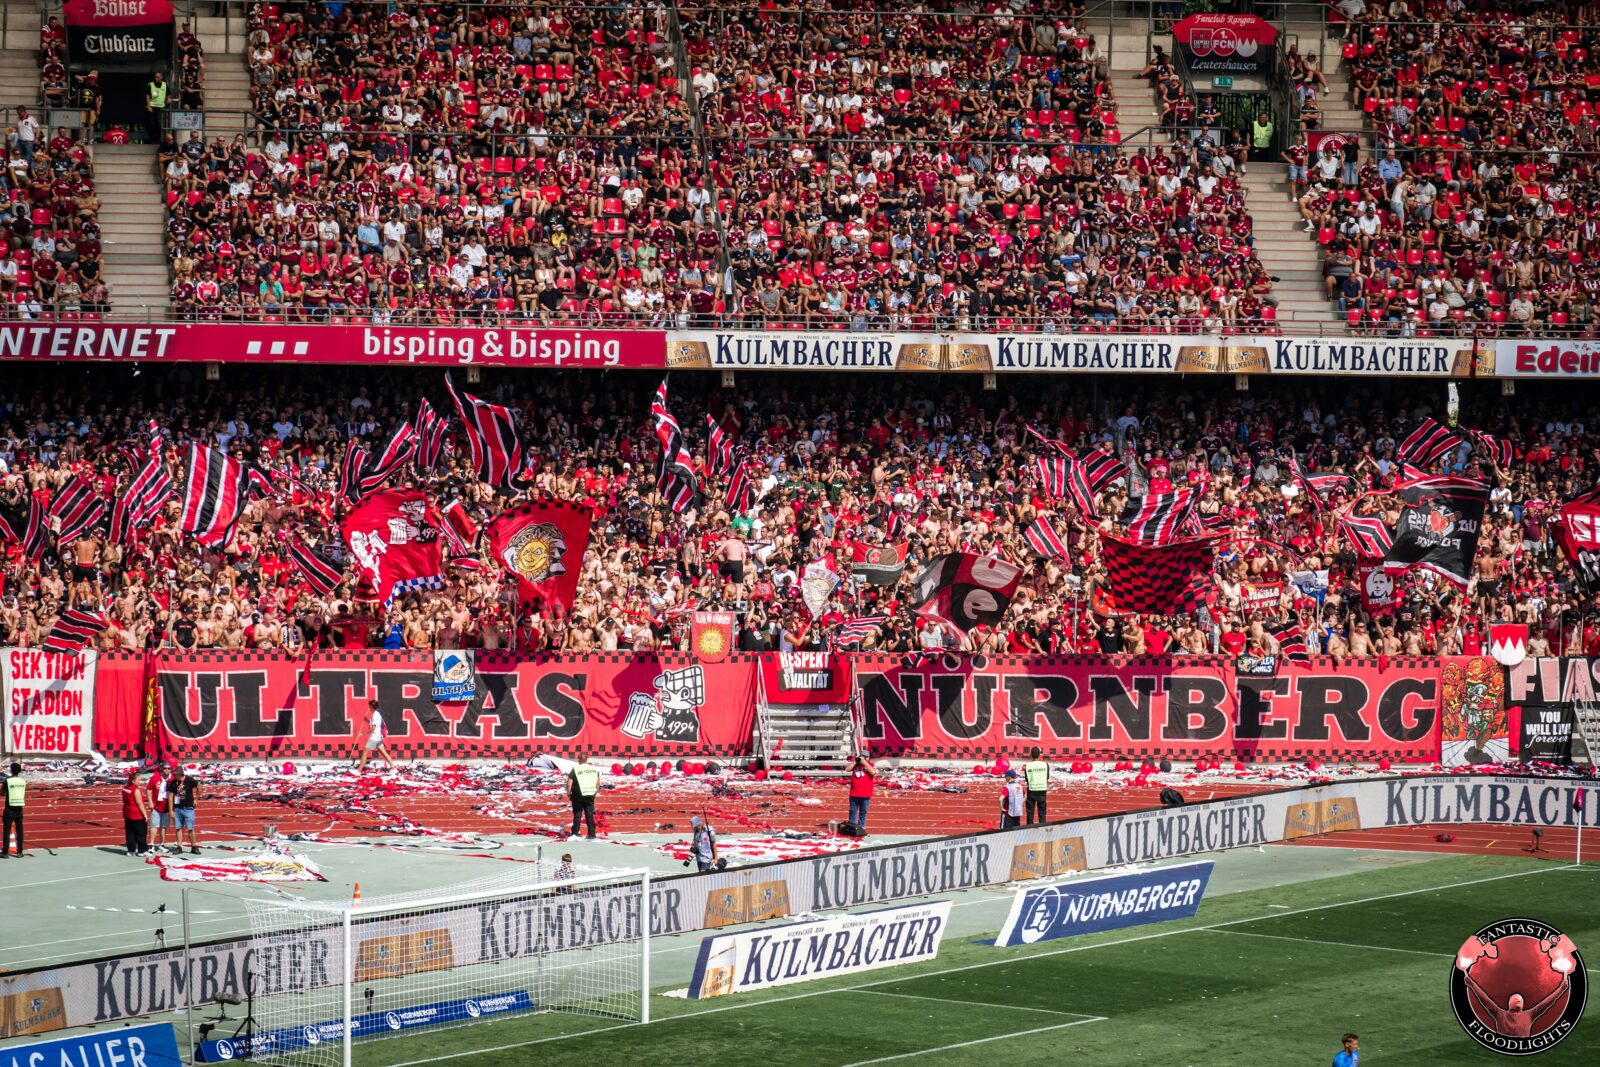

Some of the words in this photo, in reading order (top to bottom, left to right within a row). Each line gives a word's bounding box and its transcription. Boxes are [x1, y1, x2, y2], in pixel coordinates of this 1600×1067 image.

[1195, 15, 1226, 24] Fanclub
[1227, 15, 1256, 26] Rangau
[84, 35, 155, 53] Clubfanz
[1213, 41, 1235, 49] FCN
[1191, 59, 1257, 71] Leutershausen
[0, 327, 176, 357] NTERNET
[364, 328, 474, 363] bisping
[481, 331, 503, 357] &
[510, 331, 620, 365] bisping
[715, 334, 893, 366] KULMBACHER
[996, 337, 1172, 369] KULMBACHER
[1275, 340, 1449, 373] KULMBACHER
[10, 650, 85, 681] SEKTION
[780, 651, 829, 669] RESPEKT
[12, 688, 82, 716] STADION
[157, 669, 587, 740] ULTRAS
[856, 653, 1438, 742] NÜRNBERG
[432, 683, 476, 696] ULTRAS
[667, 719, 695, 733] 1994
[1525, 724, 1551, 735] WILL
[1540, 711, 1560, 723] YOU
[13, 725, 82, 752] VERBOT
[1525, 735, 1568, 748] forever
[1106, 804, 1266, 865] KULMBACHER
[811, 843, 991, 910] KULMBACHER
[1063, 879, 1200, 925] NÜRNBERGER
[478, 888, 682, 961] KULMBACHER
[739, 916, 942, 986] KULMBACHER
[94, 939, 329, 1021] KULMBACHER
